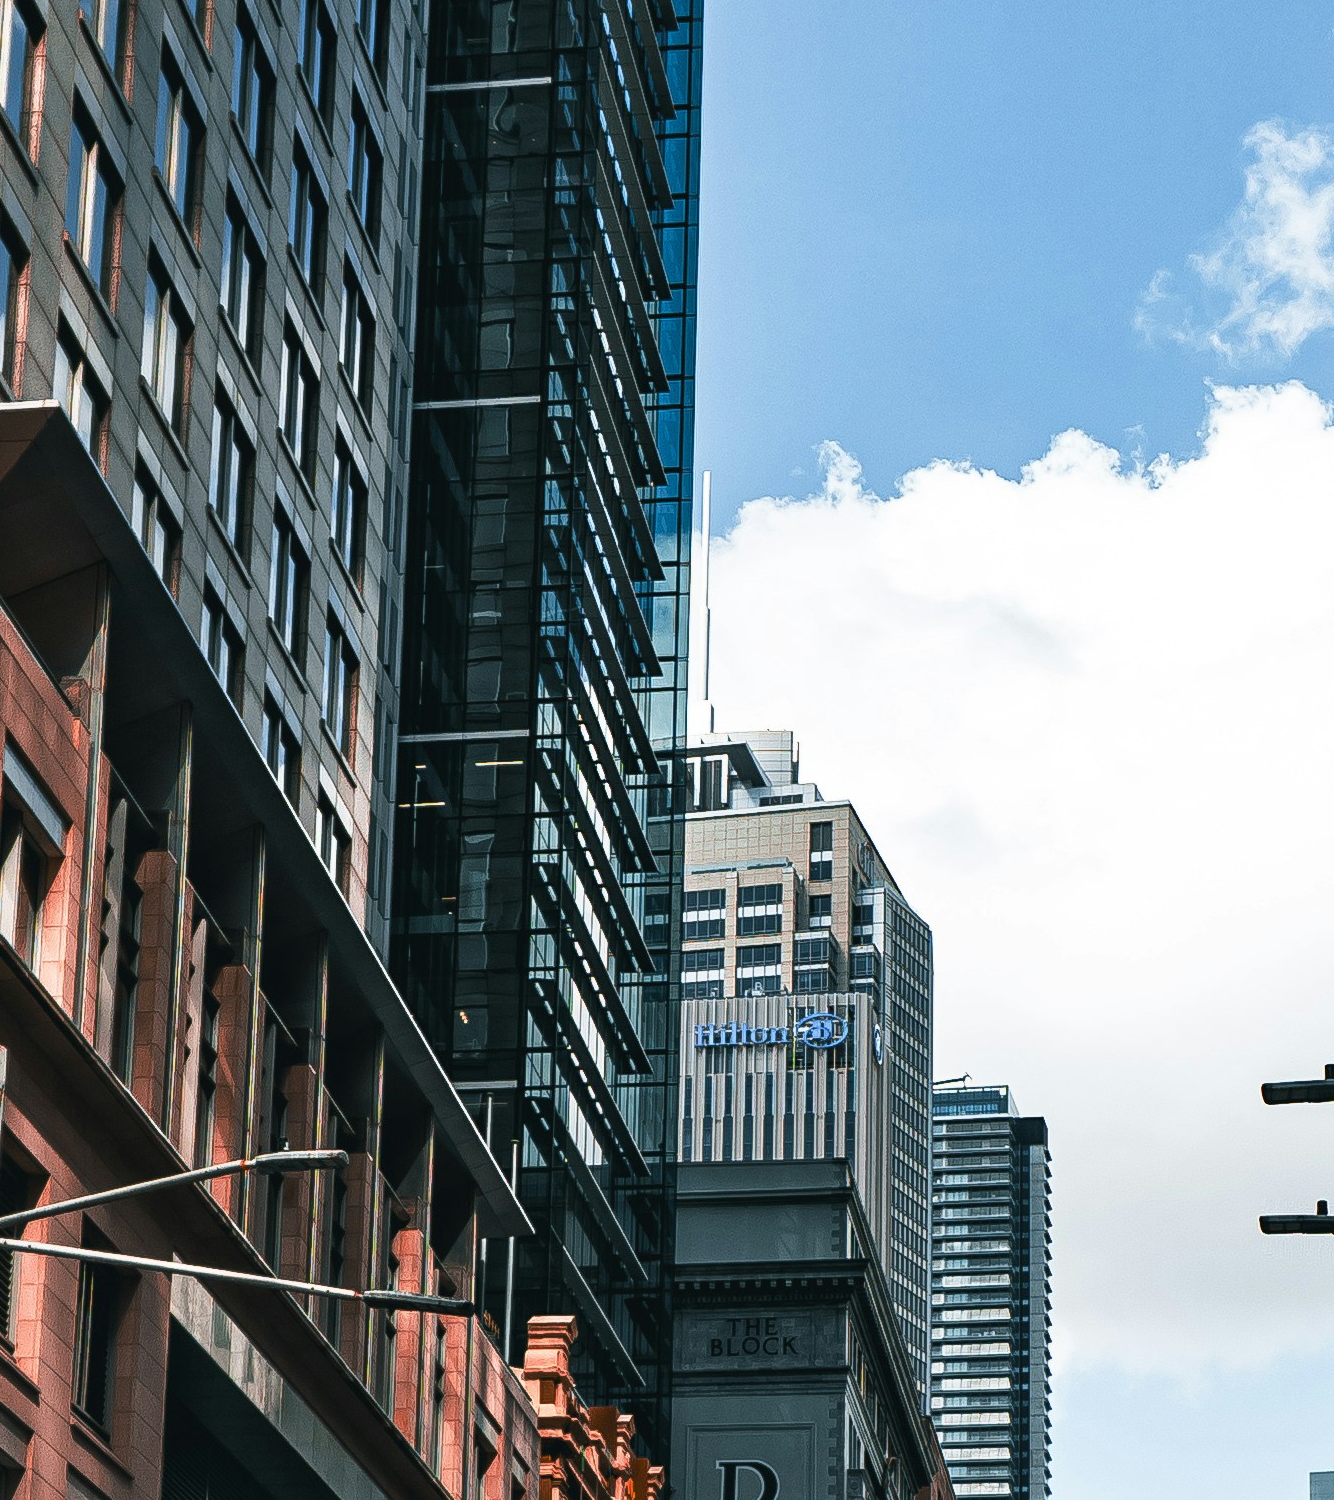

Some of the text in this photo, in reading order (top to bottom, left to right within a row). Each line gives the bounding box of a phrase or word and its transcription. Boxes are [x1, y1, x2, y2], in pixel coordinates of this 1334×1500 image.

[694, 1020, 791, 1047] Hilton
[726, 1318, 778, 1336] THE
[710, 1336, 798, 1357] BLOCK
